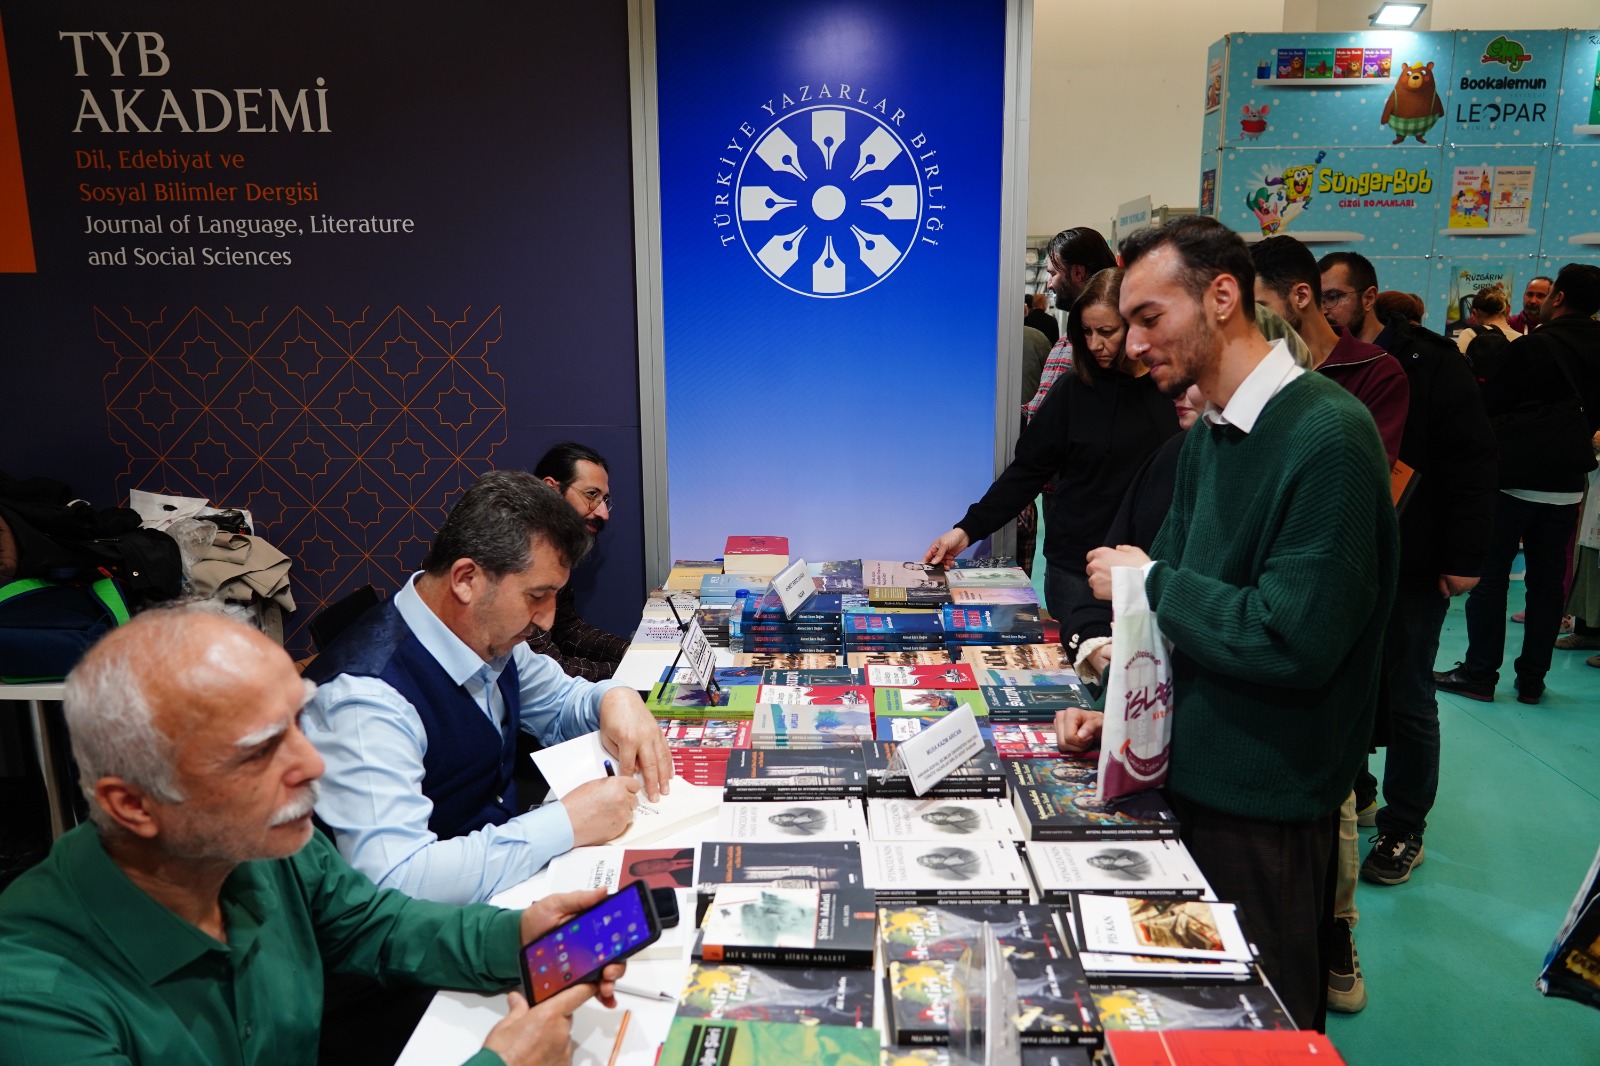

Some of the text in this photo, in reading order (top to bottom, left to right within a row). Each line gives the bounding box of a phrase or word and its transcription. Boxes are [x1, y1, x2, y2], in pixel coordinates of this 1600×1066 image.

[59, 31, 170, 77] TYB
[1460, 77, 1547, 90] Bookalemun
[72, 77, 333, 133] AKADEMİ
[76, 150, 245, 174] Dil, Edebiyat ve
[713, 83, 947, 247] TÜRKİYE YAZARLAR BİRLİĞİ
[79, 182, 318, 206] Sosyal Bilimler Dergisi
[1363, 199, 1415, 207] ROMANLARI
[84, 214, 415, 238] Journal of Language, Literature
[88, 246, 292, 266] and Social Sciences
[593, 860, 605, 889] NURETTİN
[818, 918, 829, 940] Şiirin
[813, 953, 846, 962] ADALETİ
